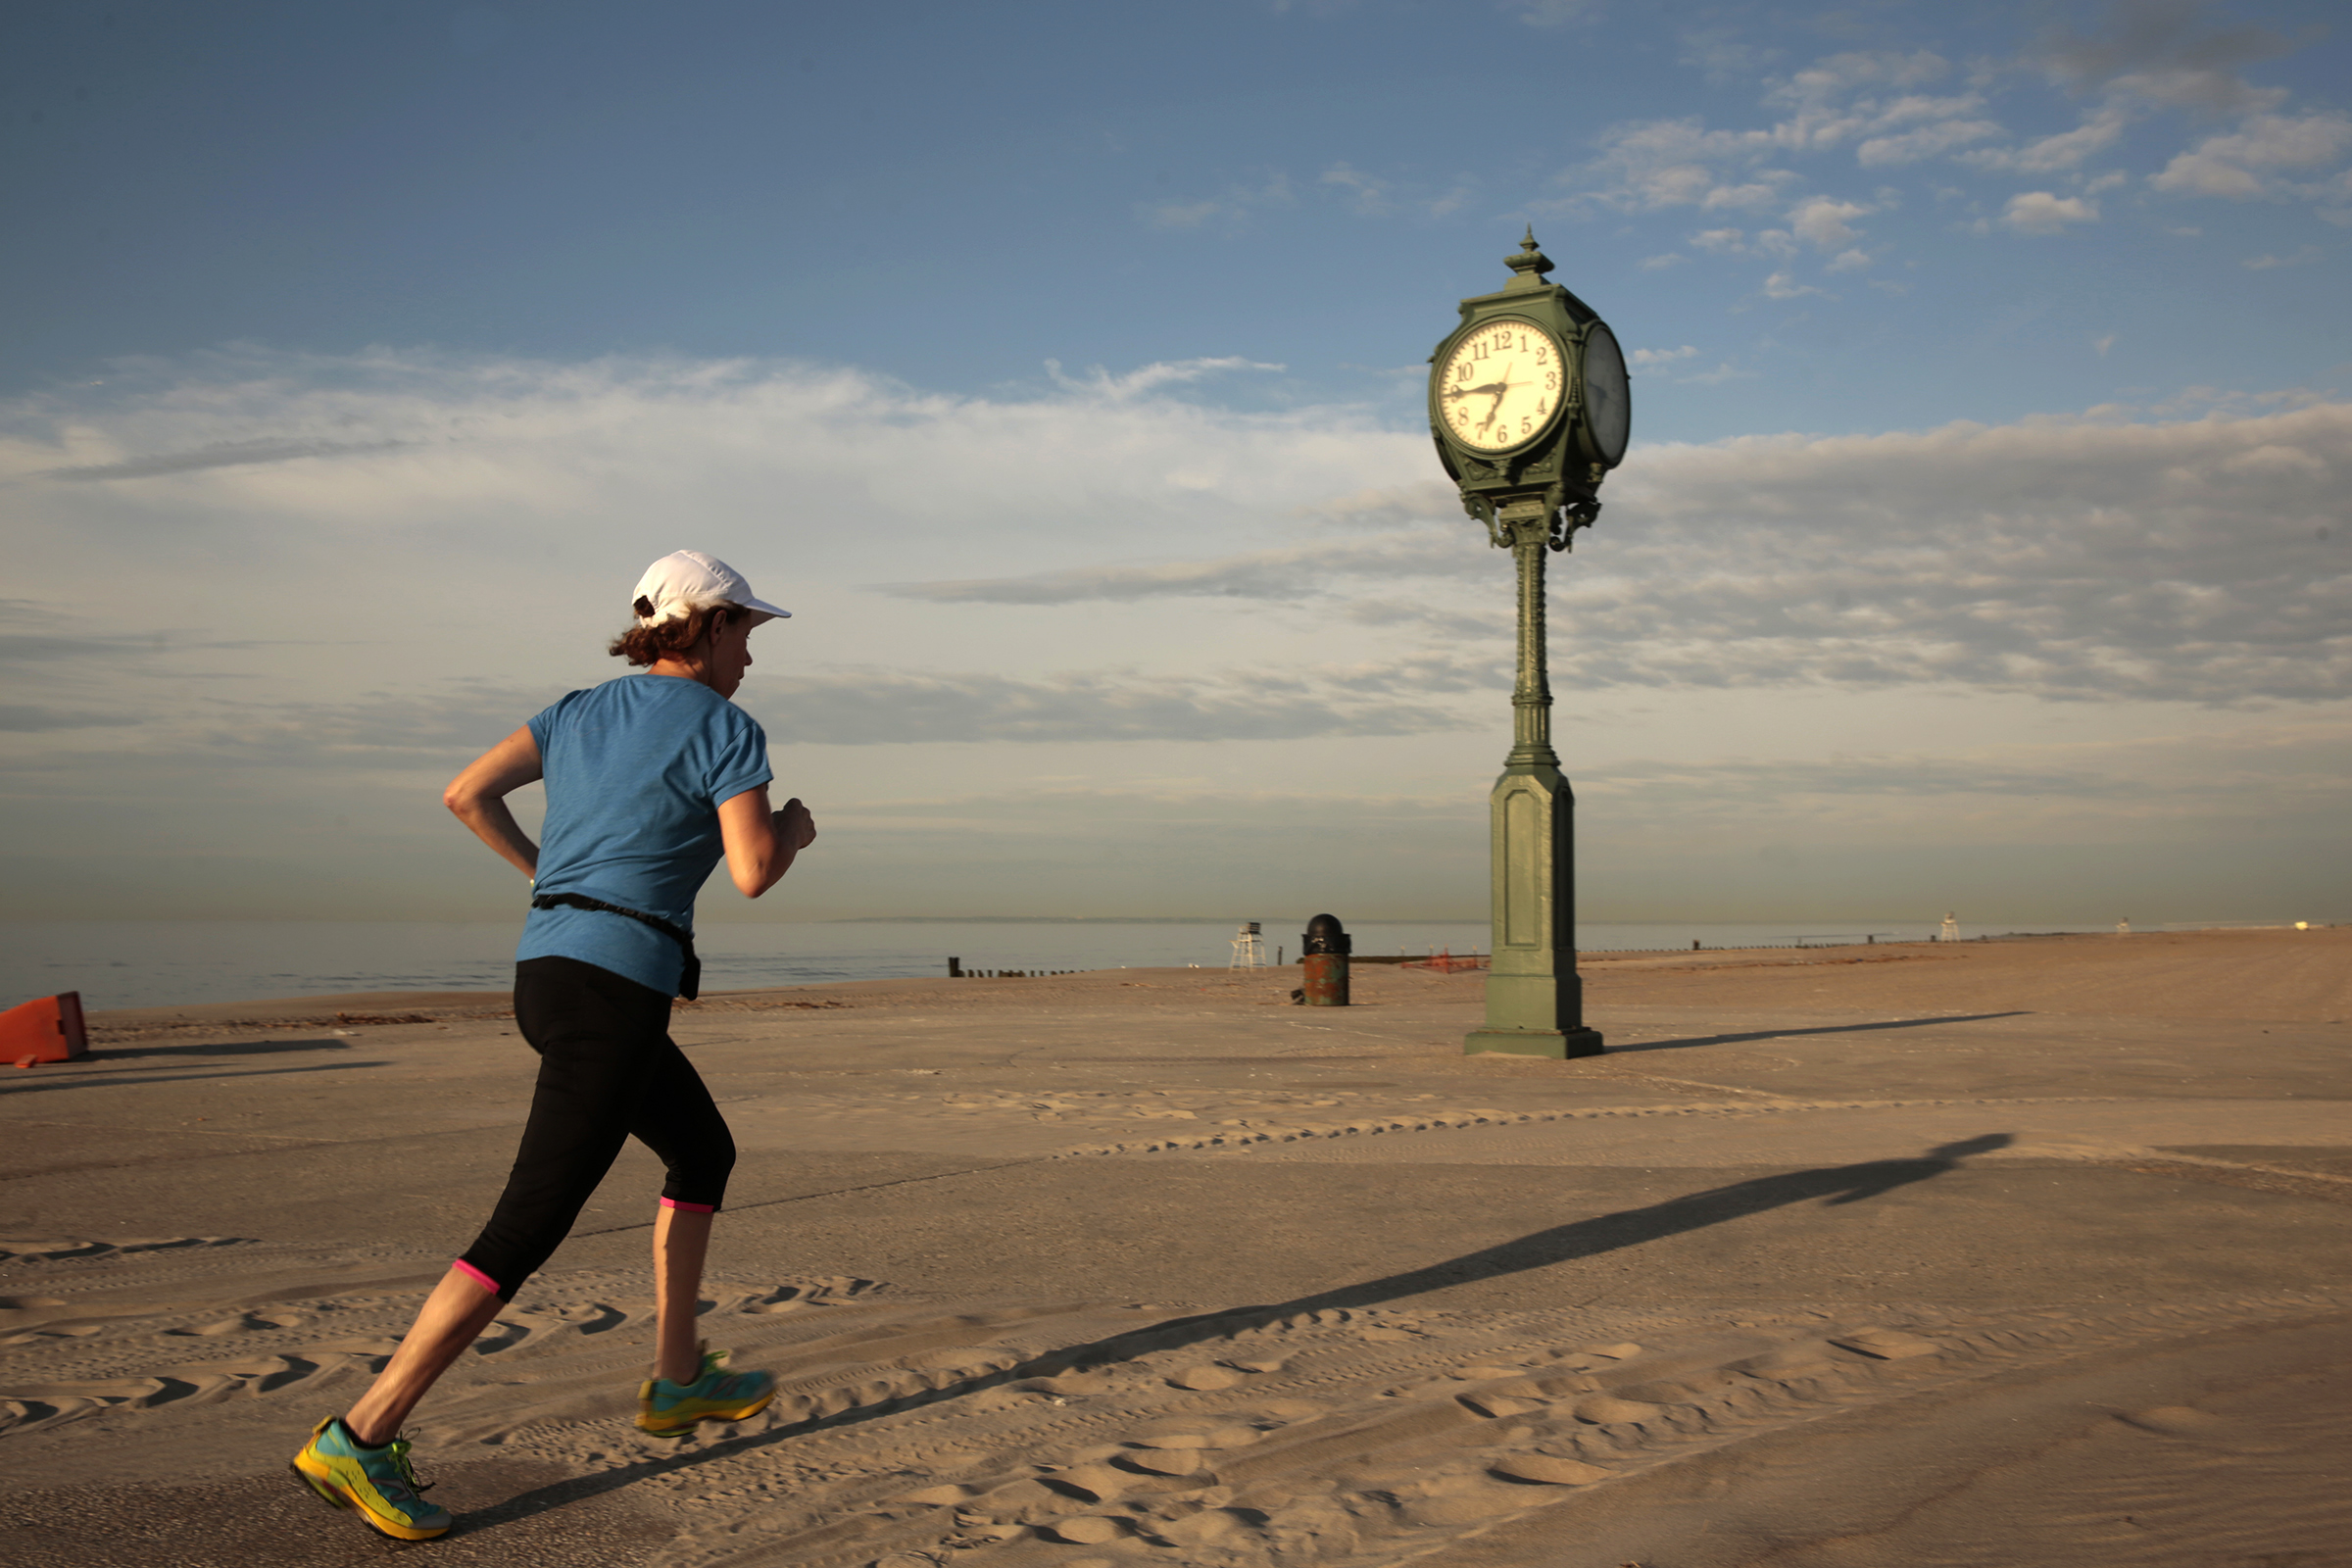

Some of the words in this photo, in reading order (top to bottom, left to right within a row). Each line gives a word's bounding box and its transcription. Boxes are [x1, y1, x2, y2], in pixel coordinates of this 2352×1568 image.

[1472, 341, 1491, 360] 11
[1493, 331, 1512, 351] 12
[1520, 335, 1528, 353] 1
[1537, 347, 1547, 366] 2
[1456, 362, 1474, 382] 10
[1545, 371, 1556, 390] 3
[1537, 396, 1547, 416] 4
[1458, 407, 1468, 425] 8
[1521, 416, 1532, 434] 5
[1475, 421, 1487, 440] 7
[1497, 424, 1507, 443] 6
